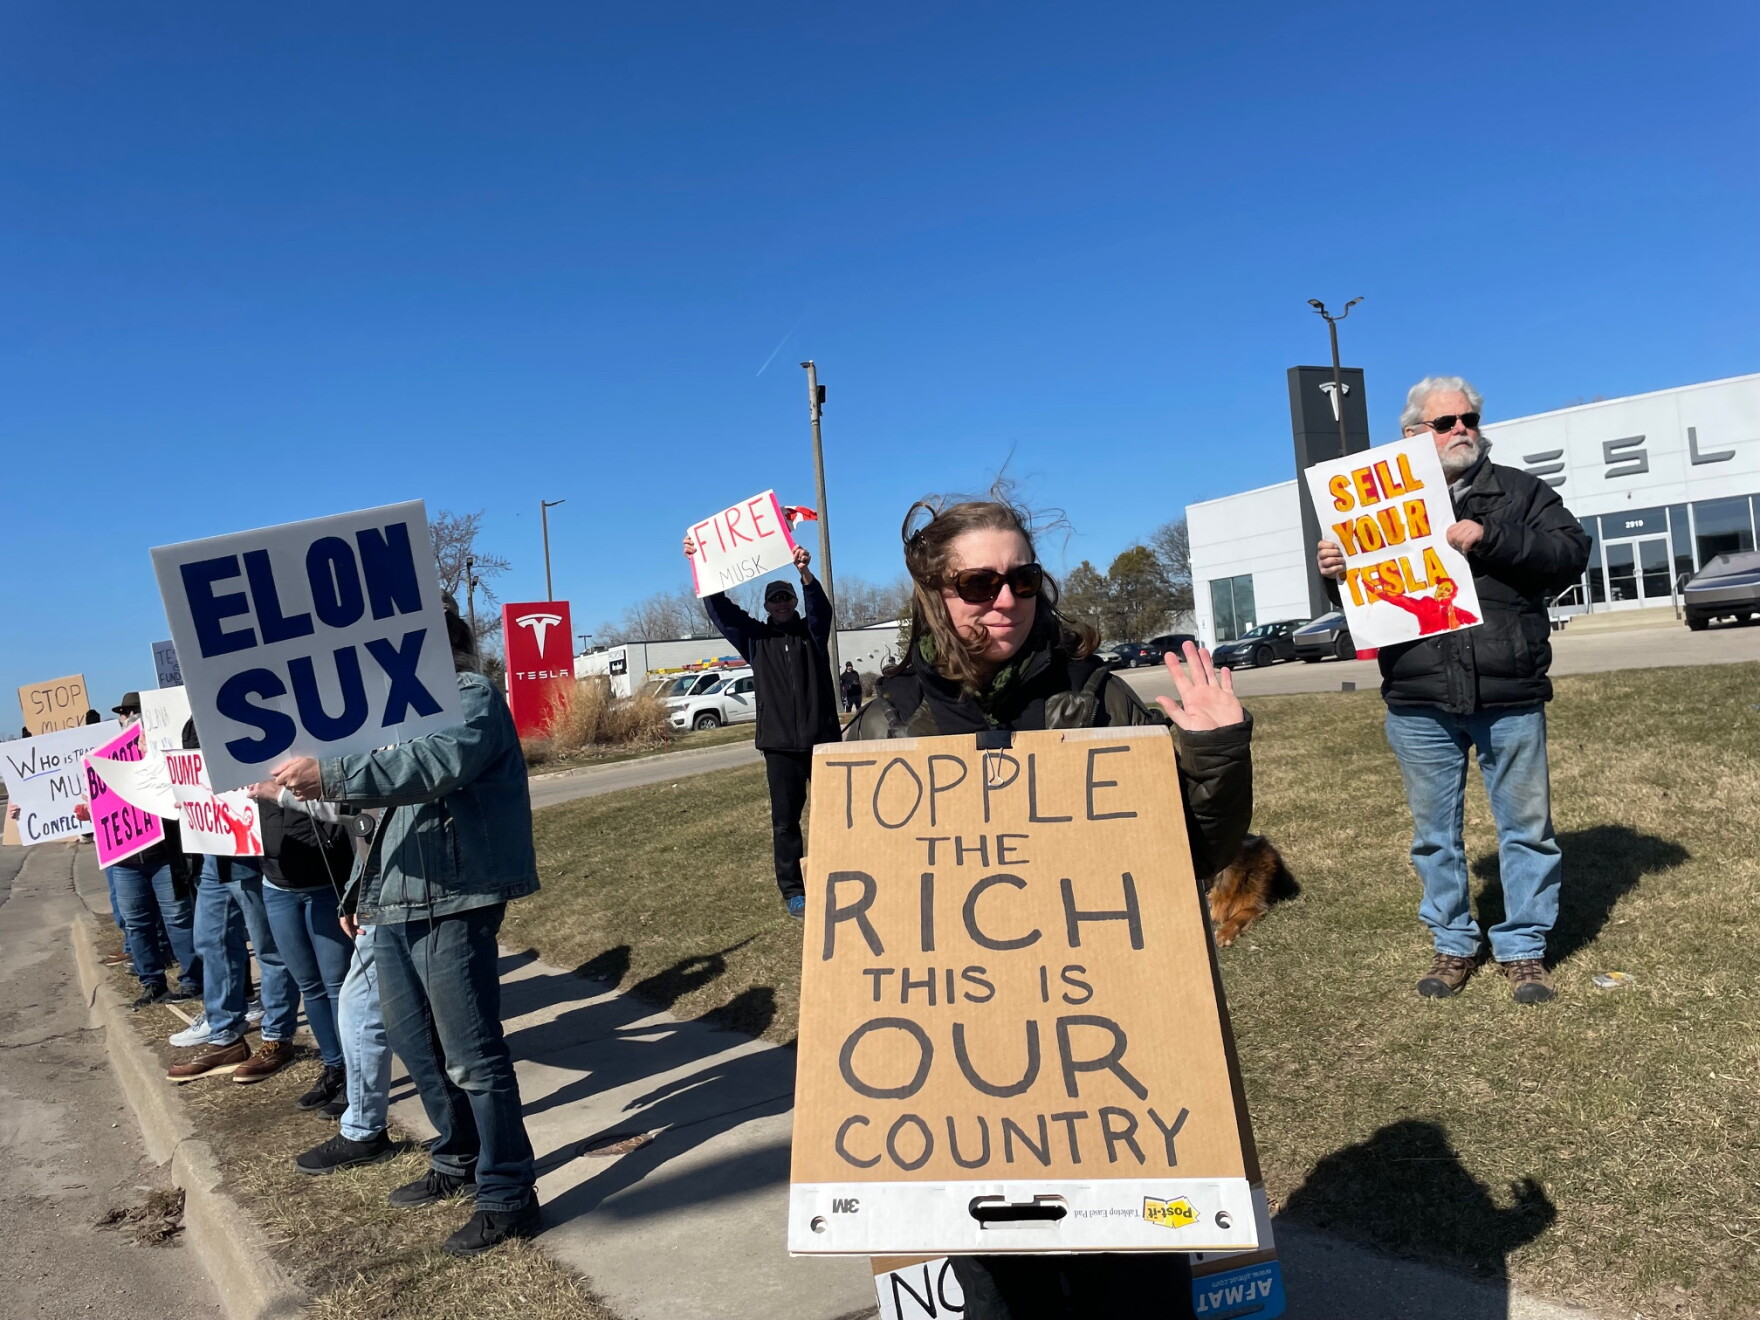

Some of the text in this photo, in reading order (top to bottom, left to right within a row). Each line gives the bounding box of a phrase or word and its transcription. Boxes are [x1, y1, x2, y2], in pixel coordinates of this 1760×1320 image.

[1329, 453, 1425, 512] SELL
[1523, 427, 1736, 487] ESL
[694, 497, 775, 563] FIRE
[1332, 499, 1431, 557] YOUR
[180, 522, 422, 658] ELON
[719, 554, 768, 588] MUSK
[1339, 546, 1449, 607] TESLA
[31, 684, 81, 714] STOP
[216, 628, 444, 764] SUX
[516, 669, 568, 680] TESLA
[166, 754, 202, 785] DUMP
[825, 745, 1138, 829] TOPPLE
[101, 805, 153, 851] TESLA
[183, 801, 232, 834] STOCKS
[916, 834, 1030, 867] THE
[822, 871, 1145, 961] RICH
[862, 965, 1093, 1006] THIS IS
[839, 1015, 1148, 1100] OUR
[835, 1106, 1189, 1171] COUNTRY
[833, 1198, 860, 1213] 3M
[1074, 1206, 1193, 1219] Post-it Tabletop Easel Pad
[1197, 1277, 1273, 1312] AFMAT
